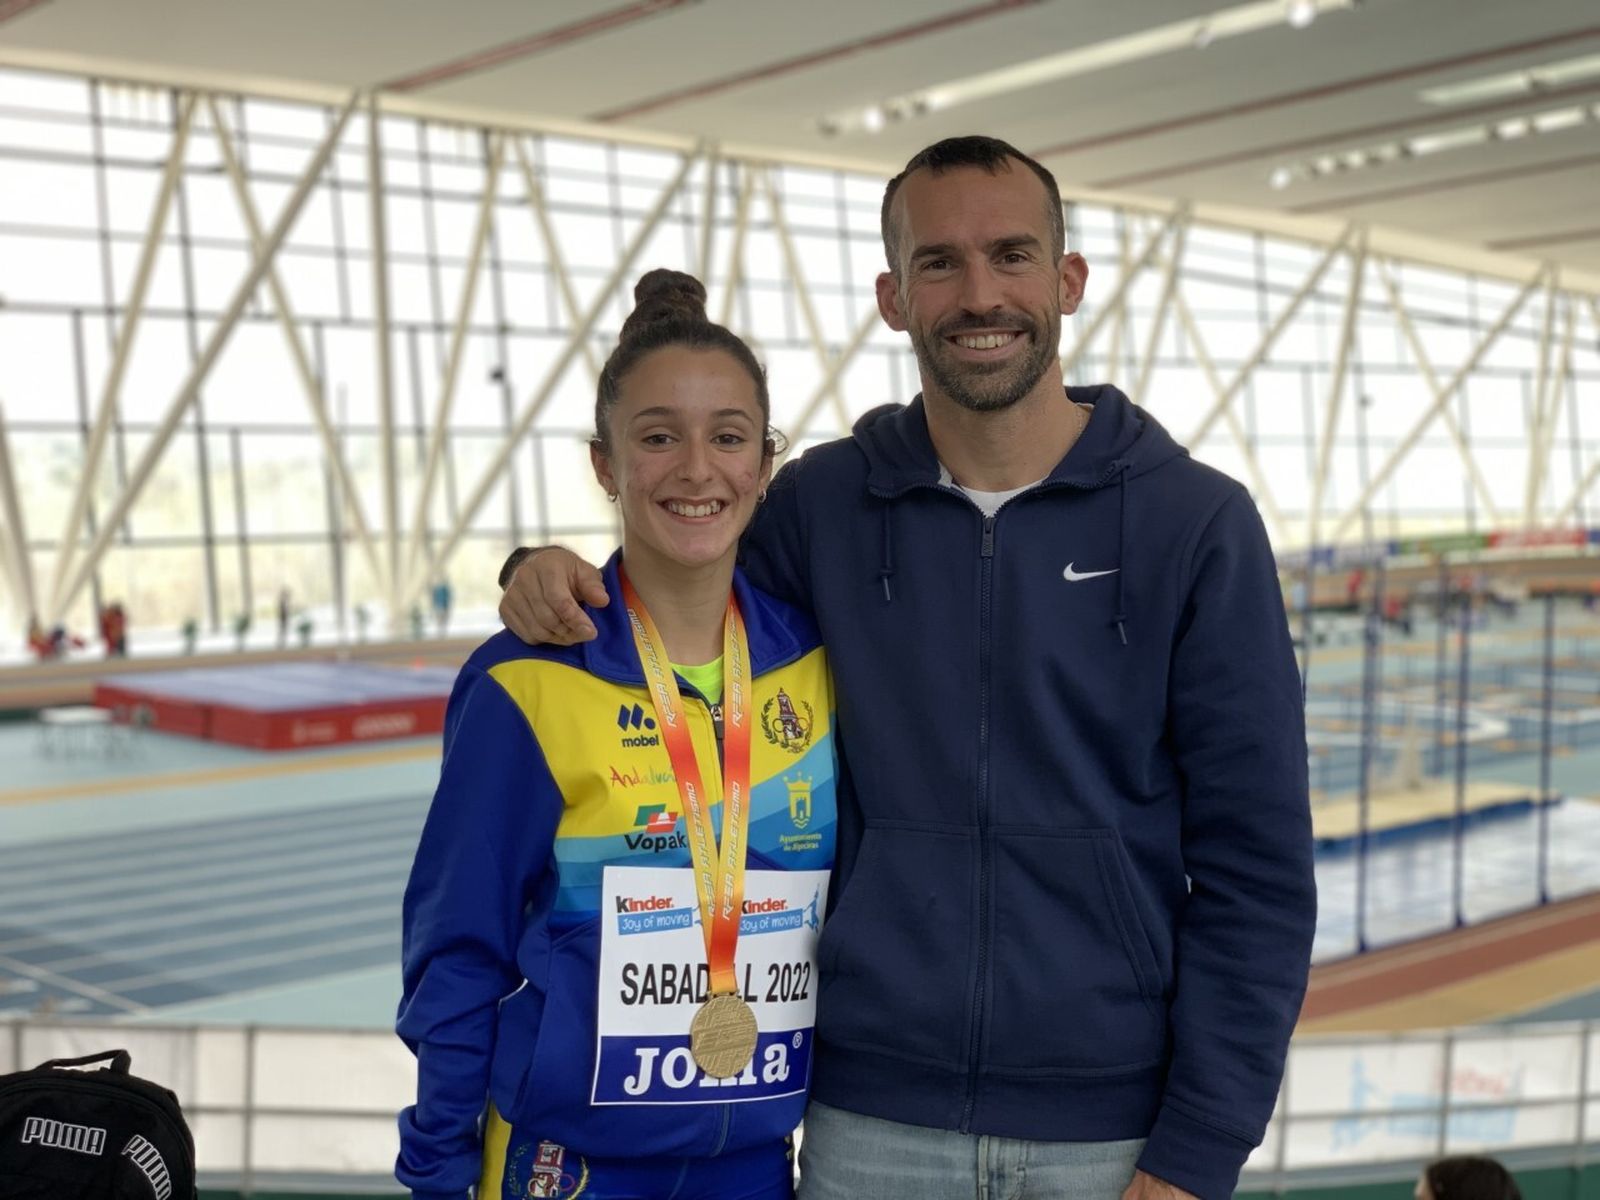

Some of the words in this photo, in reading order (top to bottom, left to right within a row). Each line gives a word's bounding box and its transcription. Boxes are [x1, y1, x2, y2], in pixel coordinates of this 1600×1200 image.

[621, 735, 660, 748] mobel
[685, 781, 710, 867] ATLETISMO
[727, 781, 741, 867] ATLETISMO
[623, 831, 687, 853] Vopak
[656, 912, 690, 927] moving
[771, 914, 801, 927] moving
[765, 961, 811, 1003] 2022
[21, 1117, 107, 1156] PUMA
